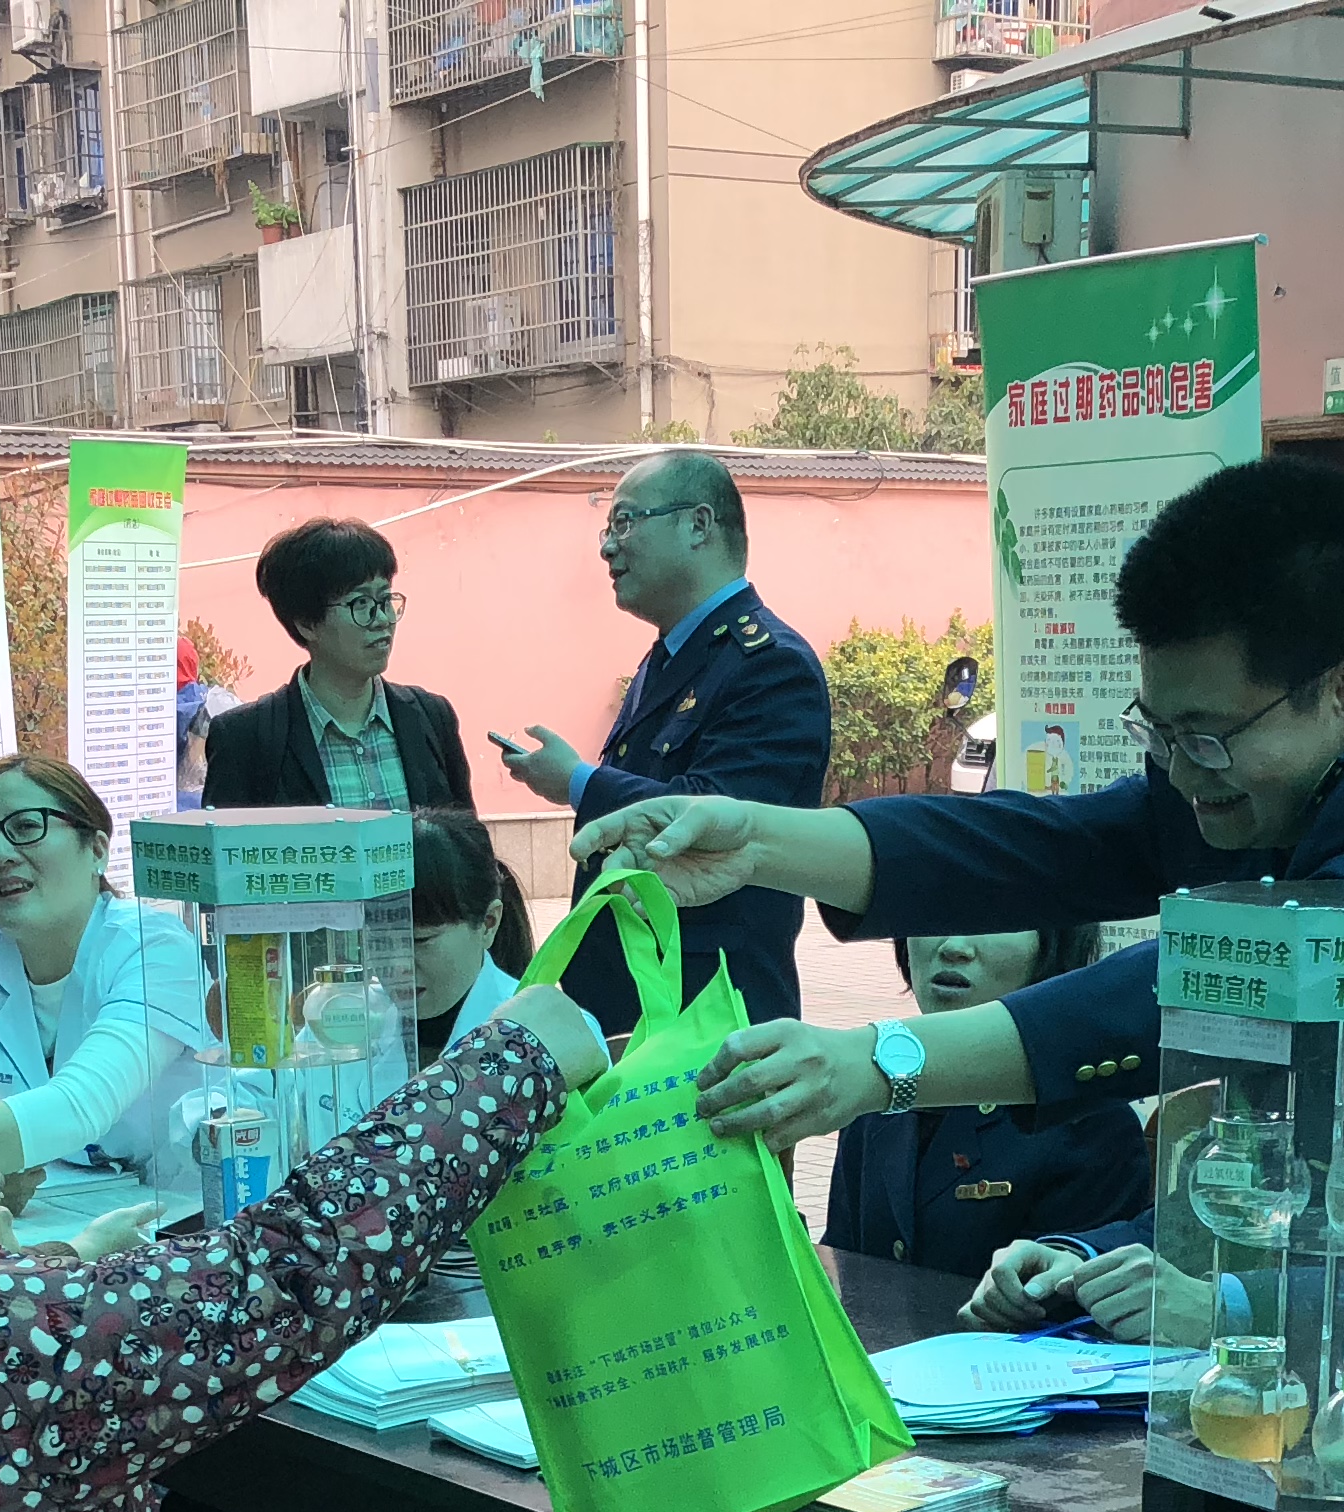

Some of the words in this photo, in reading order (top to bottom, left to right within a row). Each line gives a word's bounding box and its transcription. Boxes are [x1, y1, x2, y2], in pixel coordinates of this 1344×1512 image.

[1007, 359, 1215, 427] 家庭过期药品的危害
[133, 840, 212, 866] 下城区食品安全
[222, 845, 357, 865] 下城区食品安全
[147, 868, 200, 894] 科普宣传
[246, 873, 335, 896] 科普宣传
[374, 869, 406, 893] 科普宣传
[1163, 930, 1291, 968] 下城区食品安全
[1181, 970, 1267, 1010] 科普宣传
[582, 1406, 786, 1482] 下城区市场监督管理局
